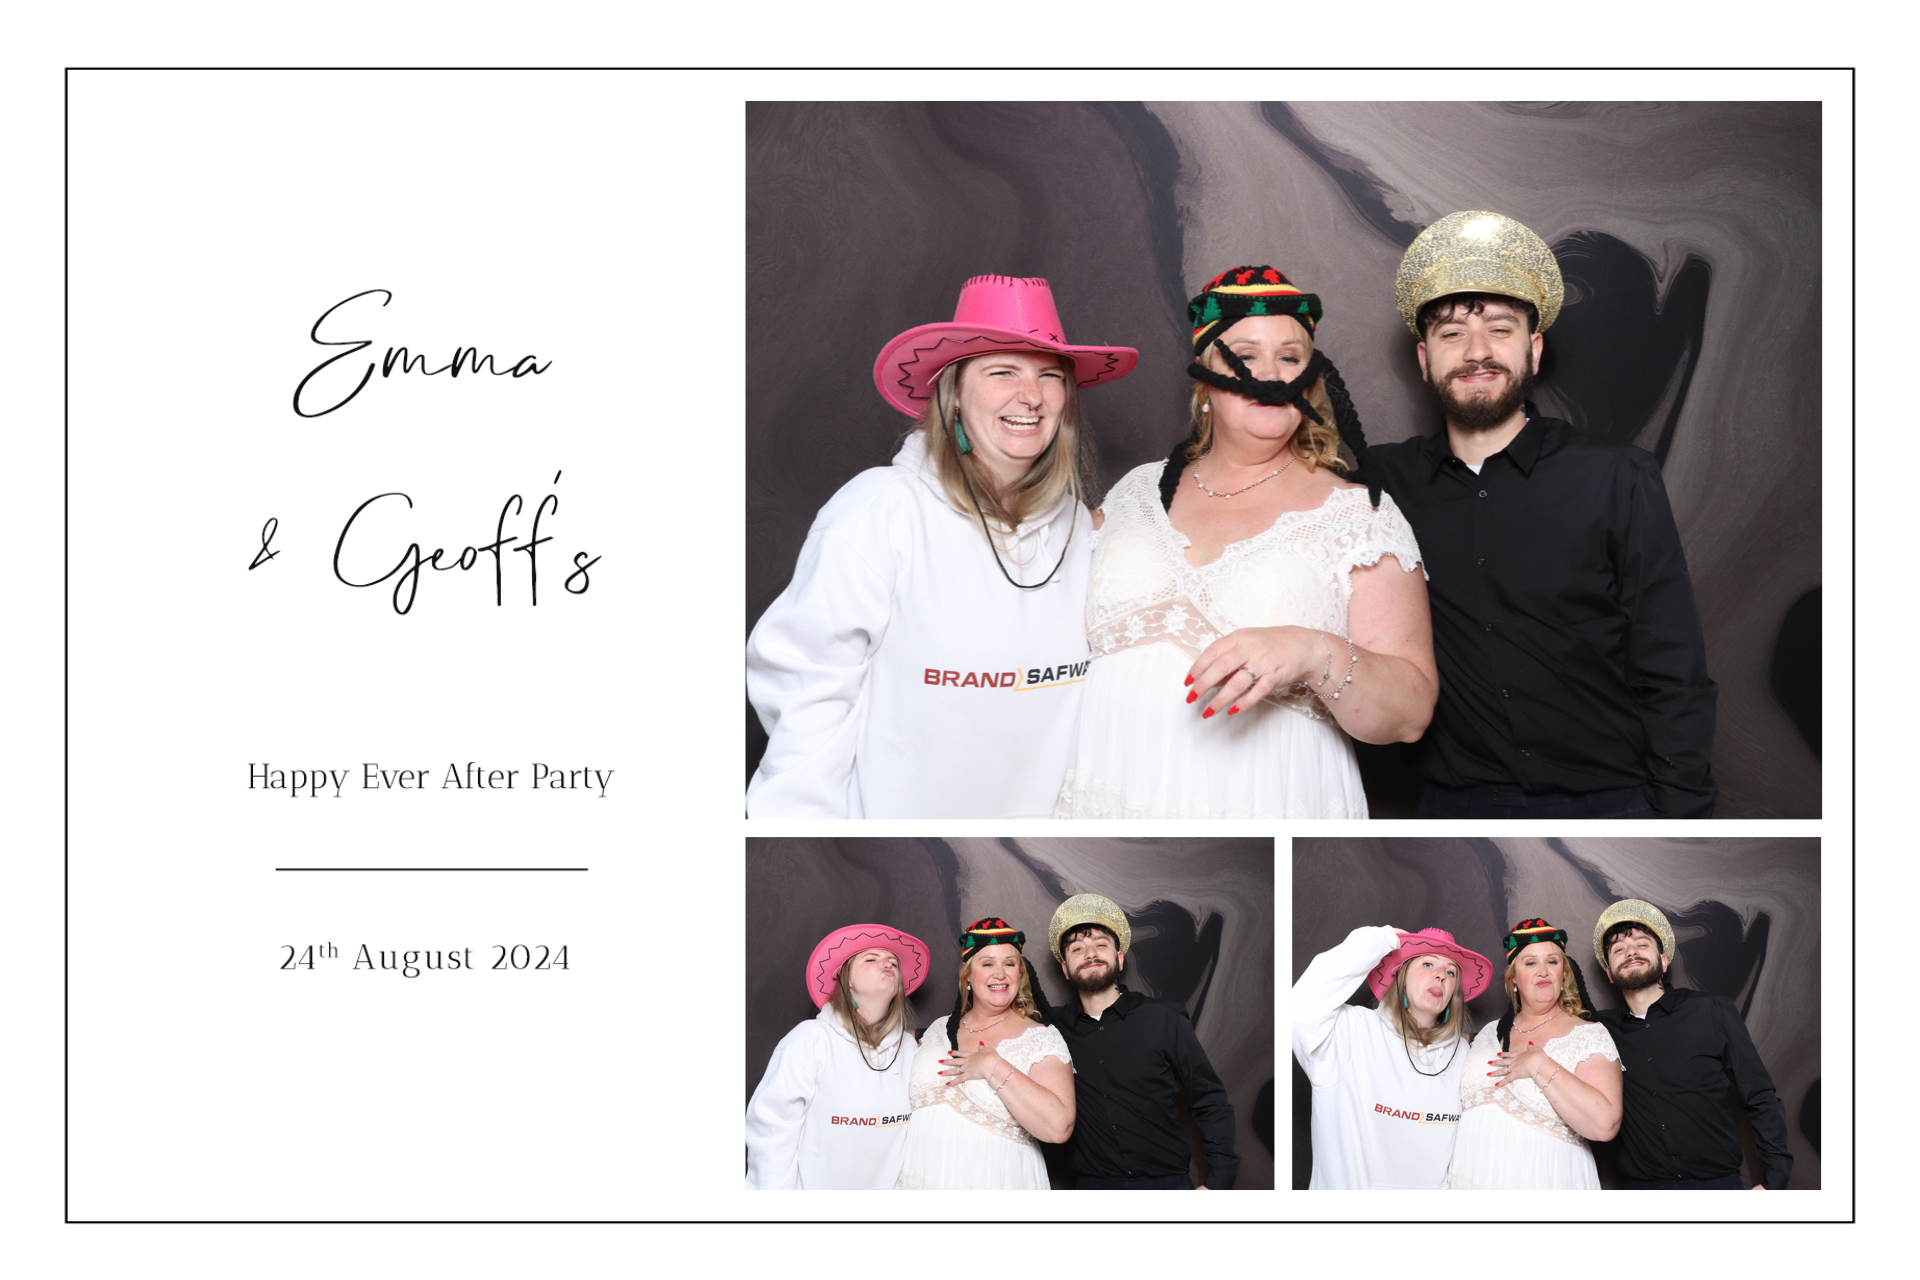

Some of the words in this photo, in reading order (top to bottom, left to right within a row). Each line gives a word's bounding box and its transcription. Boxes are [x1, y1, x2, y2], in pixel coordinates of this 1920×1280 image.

[924, 667, 1017, 689] BRAND
[831, 1115, 877, 1126] BRAND
[1374, 1103, 1421, 1121] BRAND
